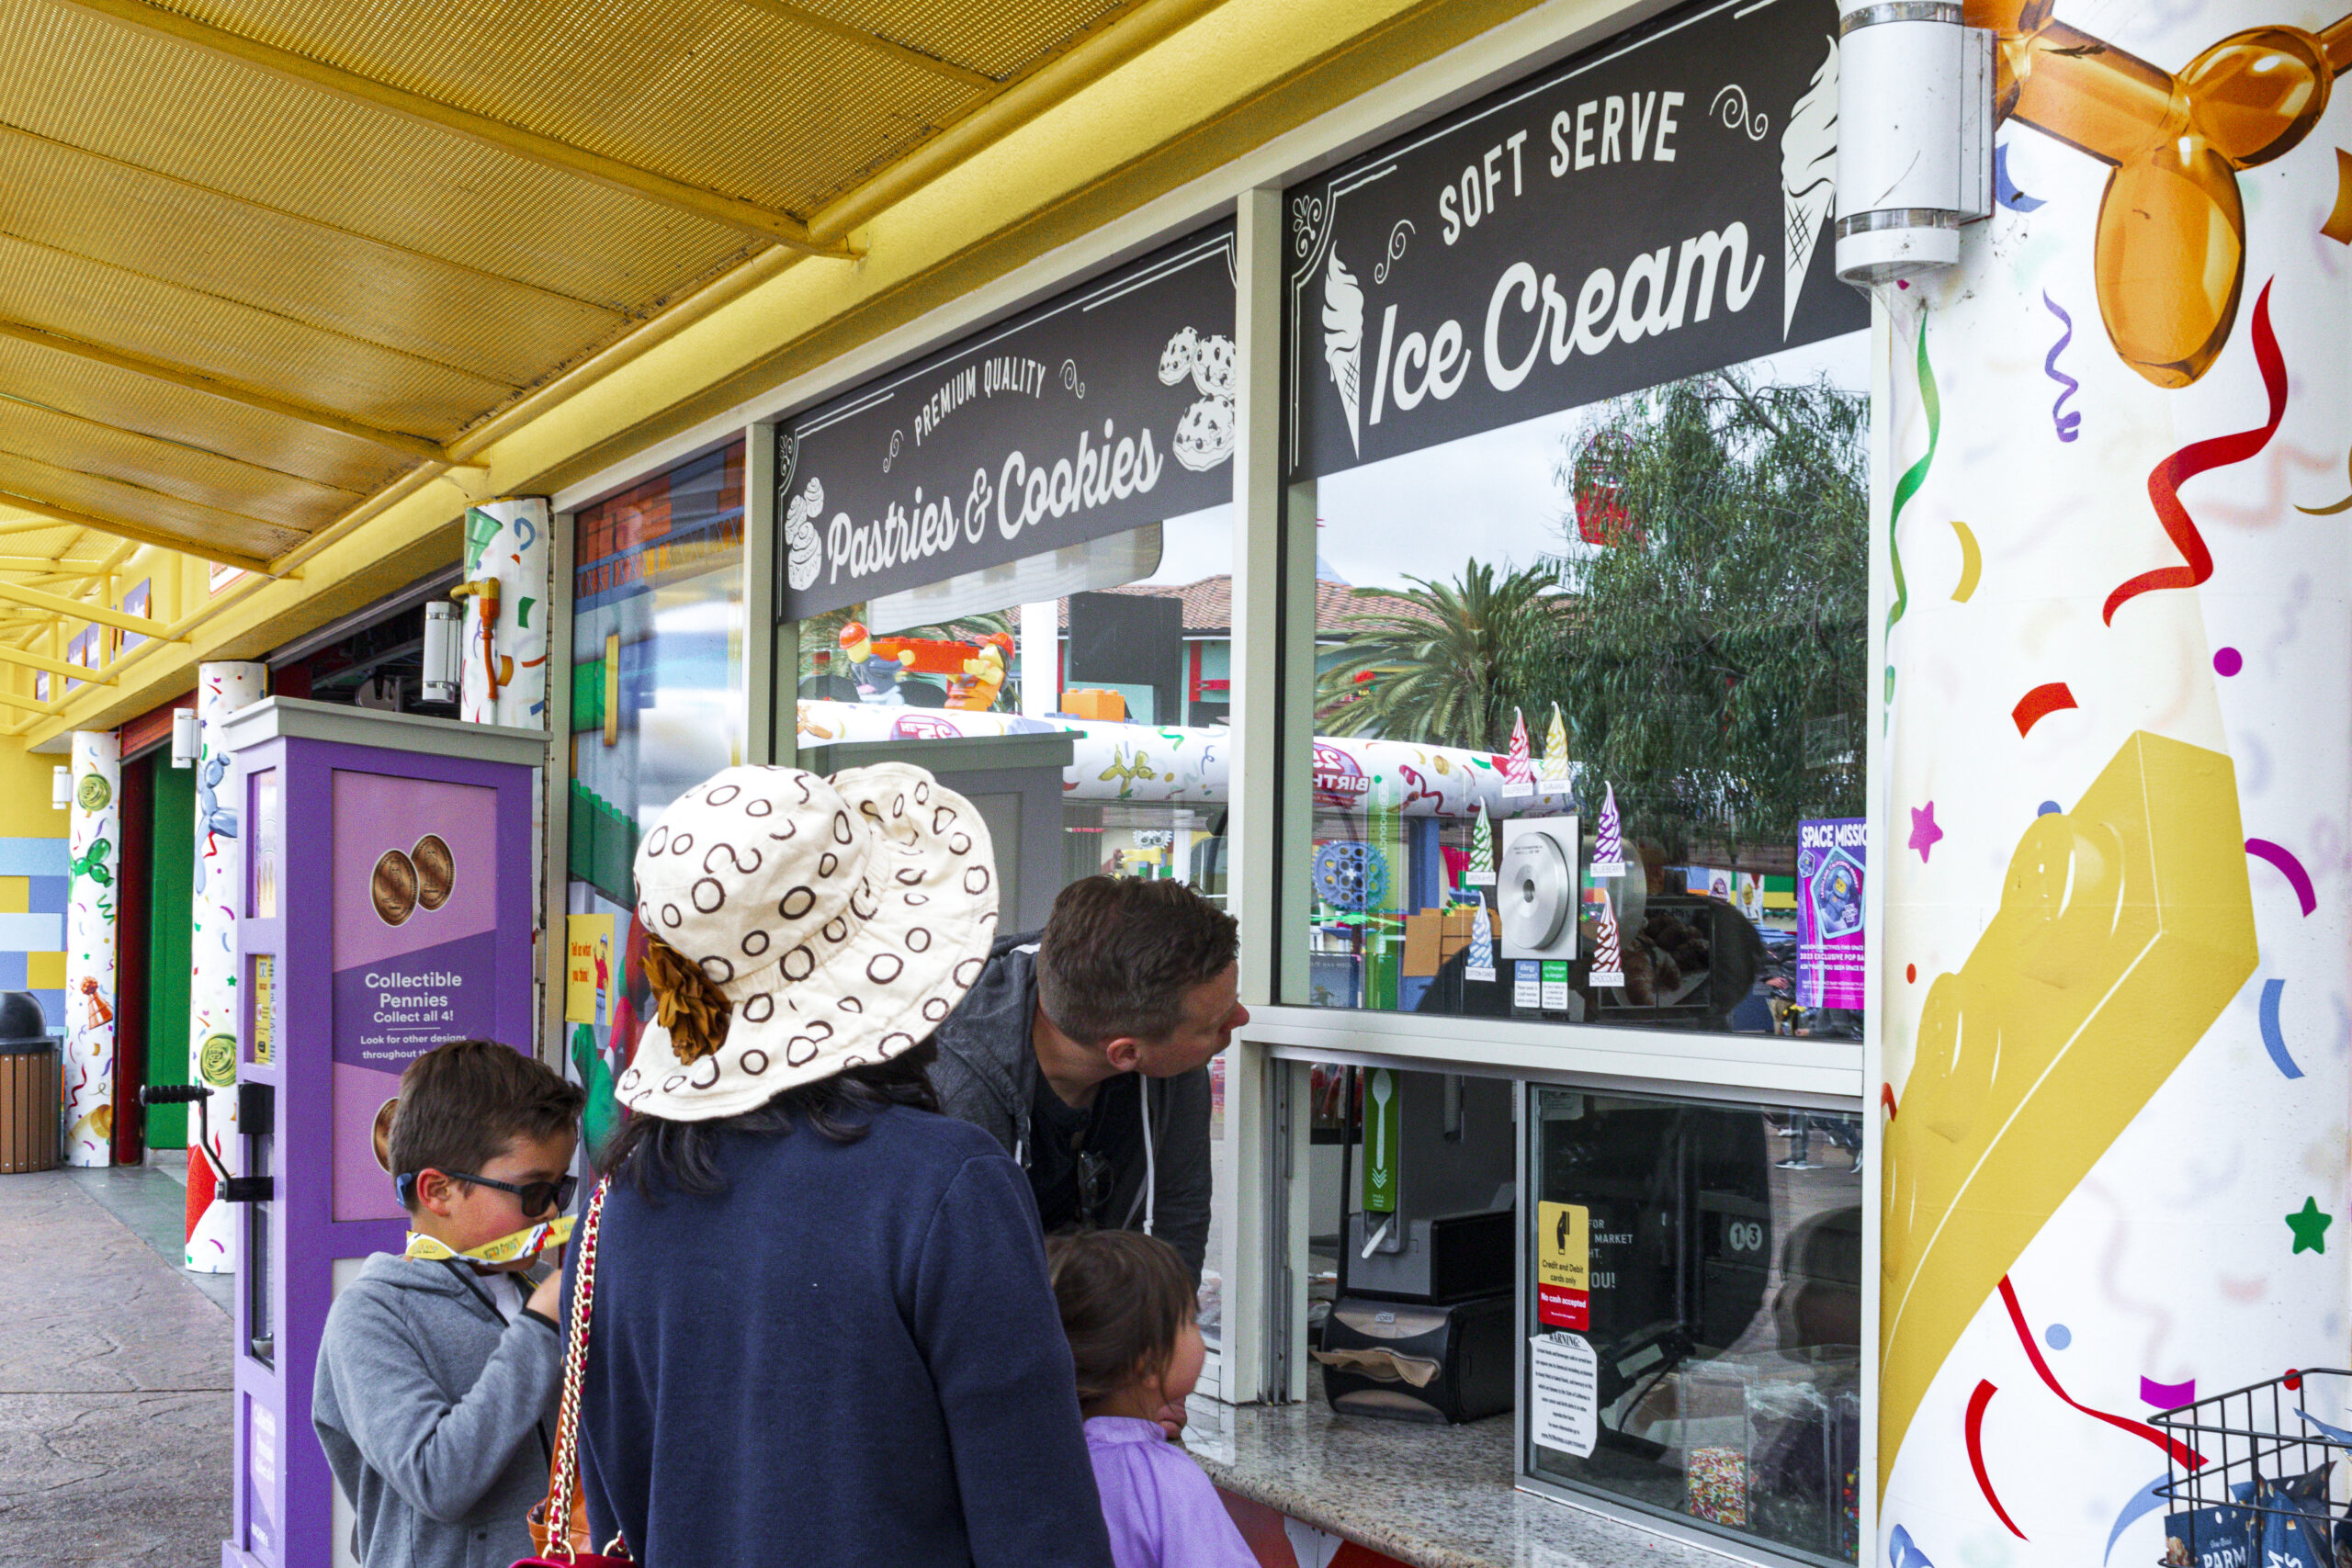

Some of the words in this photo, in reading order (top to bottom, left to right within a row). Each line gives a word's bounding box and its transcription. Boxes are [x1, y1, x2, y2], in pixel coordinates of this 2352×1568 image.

[1439, 130, 1527, 245] SOFT
[1550, 92, 1685, 177] SERVE
[1369, 304, 1471, 425] Ice
[1484, 221, 1765, 391] Cream
[914, 365, 977, 446] PREMIUM
[984, 356, 1046, 399] QUALITY
[828, 486, 959, 584] Pastries
[965, 468, 992, 544] &
[998, 419, 1164, 539] Cookies
[1802, 825, 1834, 848] SPACE
[365, 971, 462, 988] Collectible
[1590, 974, 1623, 984] CHOCOLATE
[379, 992, 448, 1008] Pennies
[373, 1010, 420, 1022] Collect
[423, 1010, 437, 1021] all
[441, 1010, 454, 1021] 4!
[360, 1035, 384, 1044] Look
[387, 1034, 401, 1043] for
[402, 1034, 428, 1043] other
[430, 1032, 467, 1043] designs
[362, 1049, 416, 1061] throughout
[1594, 1234, 1634, 1244] MARKET
[1542, 1259, 1558, 1269] Credit
[1559, 1262, 1568, 1271] and
[1569, 1263, 1584, 1273] Debit
[1550, 1274, 1565, 1283] cards
[1566, 1275, 1577, 1286] only
[1589, 1272, 1616, 1289] OU!
[1541, 1292, 1548, 1302] No
[1549, 1294, 1562, 1304] cash
[1562, 1297, 1587, 1309] accepted
[2202, 1546, 2247, 1568] PARM
